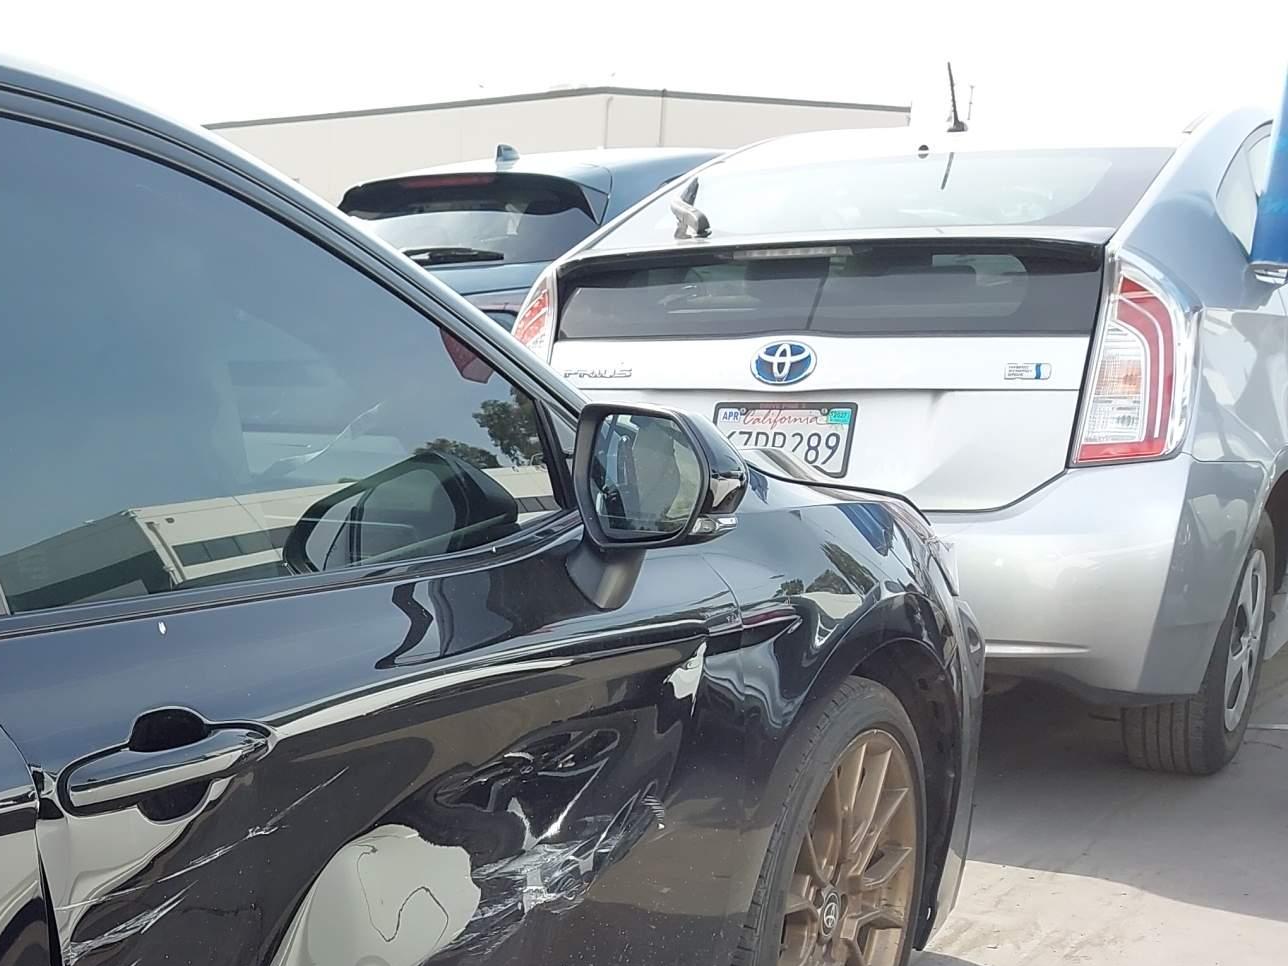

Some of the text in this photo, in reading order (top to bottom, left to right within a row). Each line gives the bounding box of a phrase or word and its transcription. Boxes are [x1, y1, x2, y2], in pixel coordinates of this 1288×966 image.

[563, 367, 633, 379] PRIUS
[722, 411, 739, 421] APR
[743, 408, 820, 431] California
